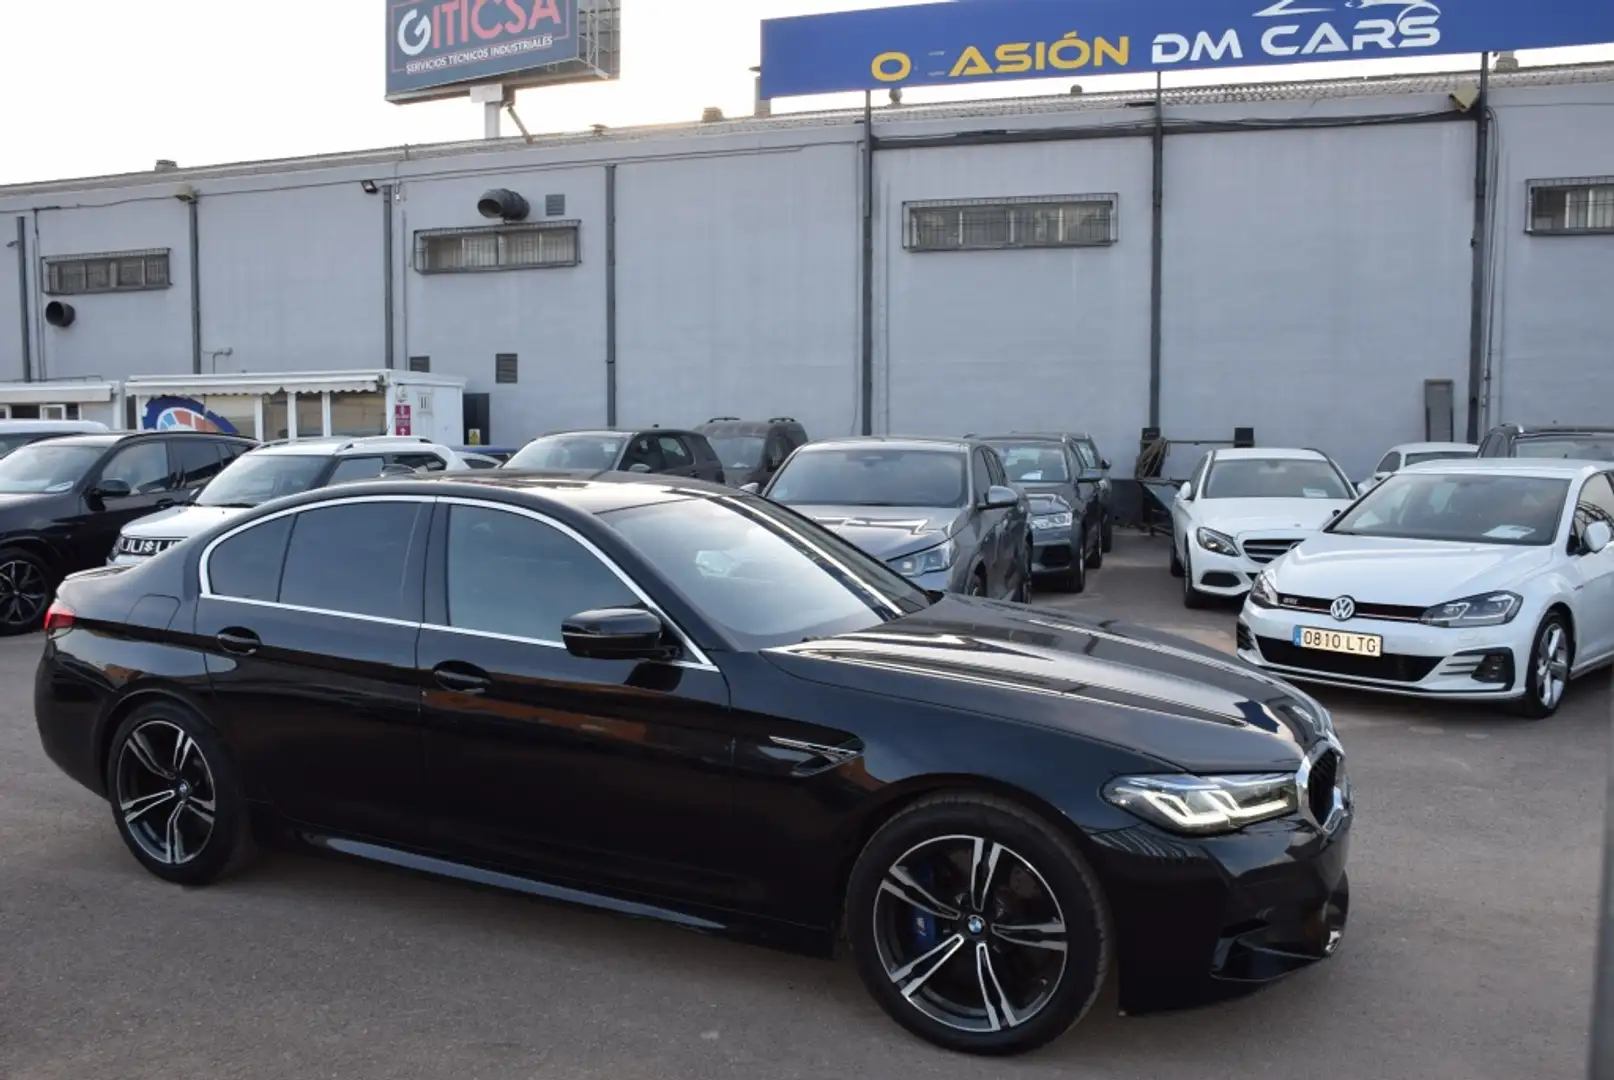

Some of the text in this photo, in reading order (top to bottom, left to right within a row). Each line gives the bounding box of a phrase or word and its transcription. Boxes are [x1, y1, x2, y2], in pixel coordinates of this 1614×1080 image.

[397, 0, 561, 56] GITICSA
[871, 15, 1441, 82] OASIÓN DM CARS
[406, 57, 448, 75] SERVICIOS
[490, 35, 553, 57] INDUSTRIALES
[1303, 630, 1341, 649] 0810
[1346, 634, 1376, 653] LTG
